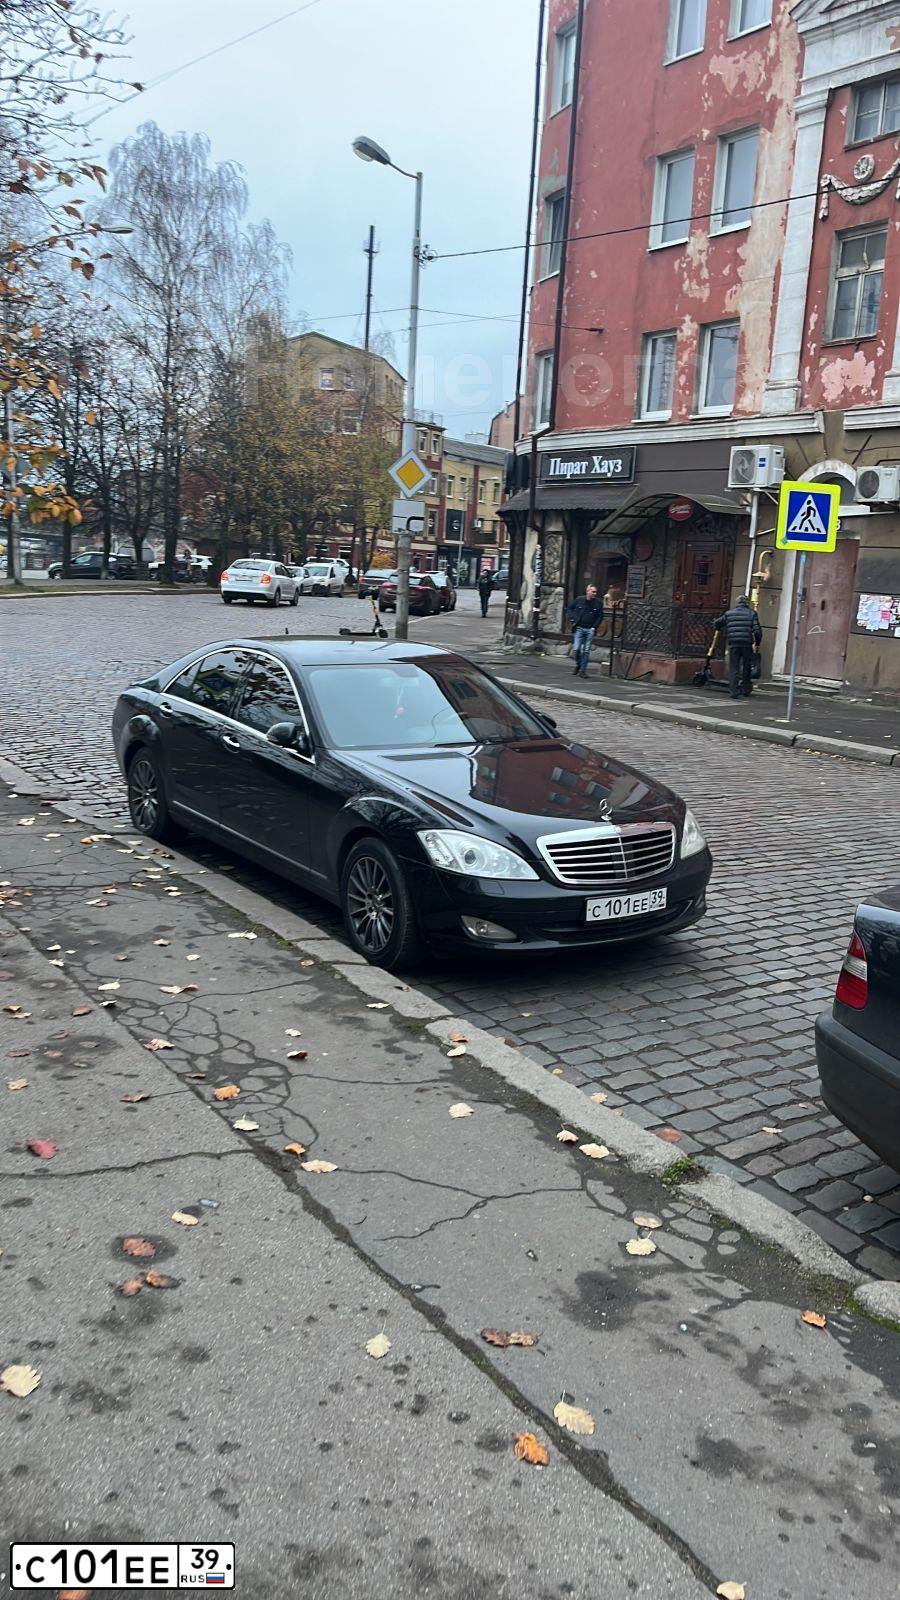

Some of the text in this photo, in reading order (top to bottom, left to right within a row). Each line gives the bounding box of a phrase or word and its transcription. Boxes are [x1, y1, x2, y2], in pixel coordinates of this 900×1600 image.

[549, 455, 622, 479] Пират Хауз
[651, 891, 663, 904] 39
